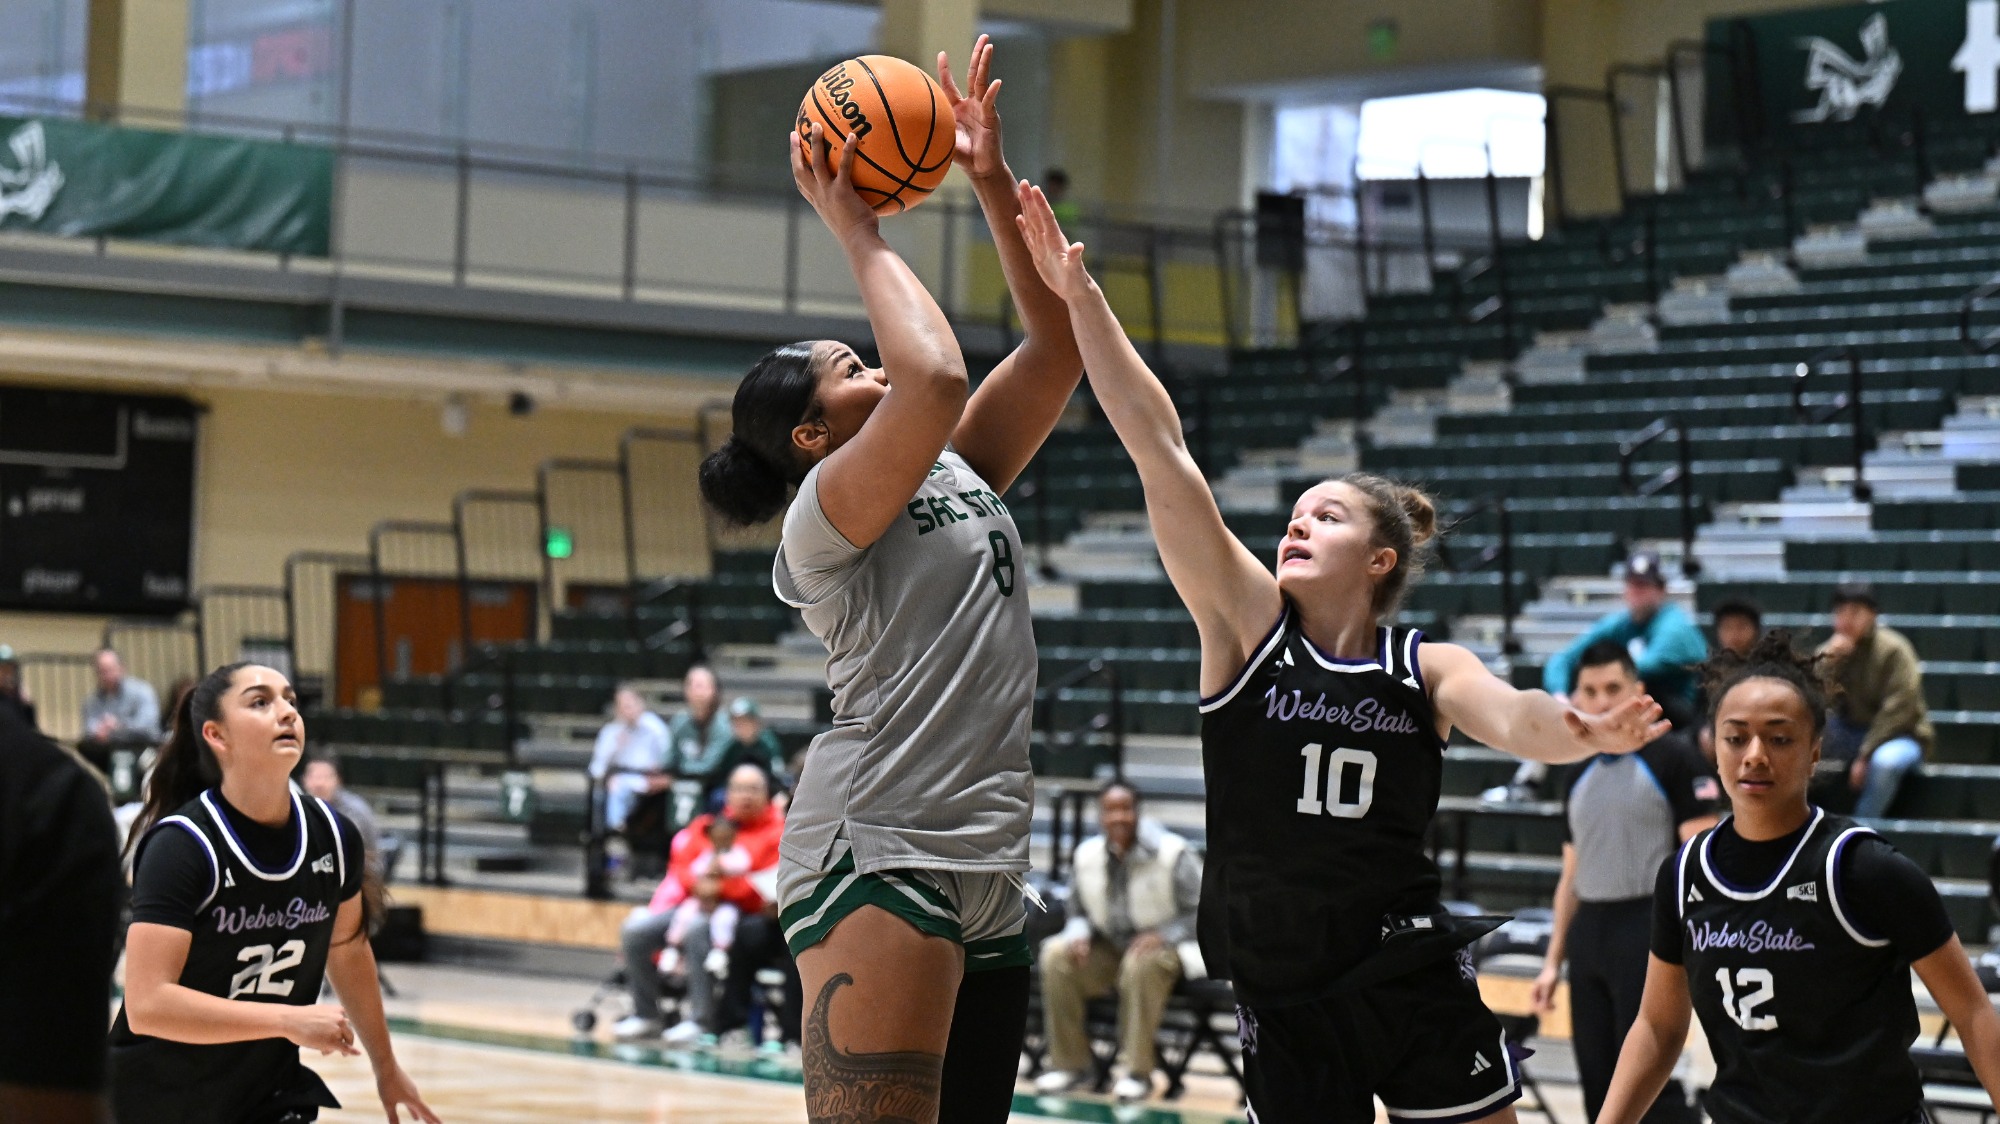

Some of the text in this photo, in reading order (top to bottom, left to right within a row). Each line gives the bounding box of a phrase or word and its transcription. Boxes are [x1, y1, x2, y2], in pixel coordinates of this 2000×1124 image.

[907, 496, 969, 536] SAC
[988, 530, 1015, 597] 8
[1296, 742, 1378, 819] 10
[227, 939, 306, 1000] 22
[1715, 967, 1778, 1031] 12
